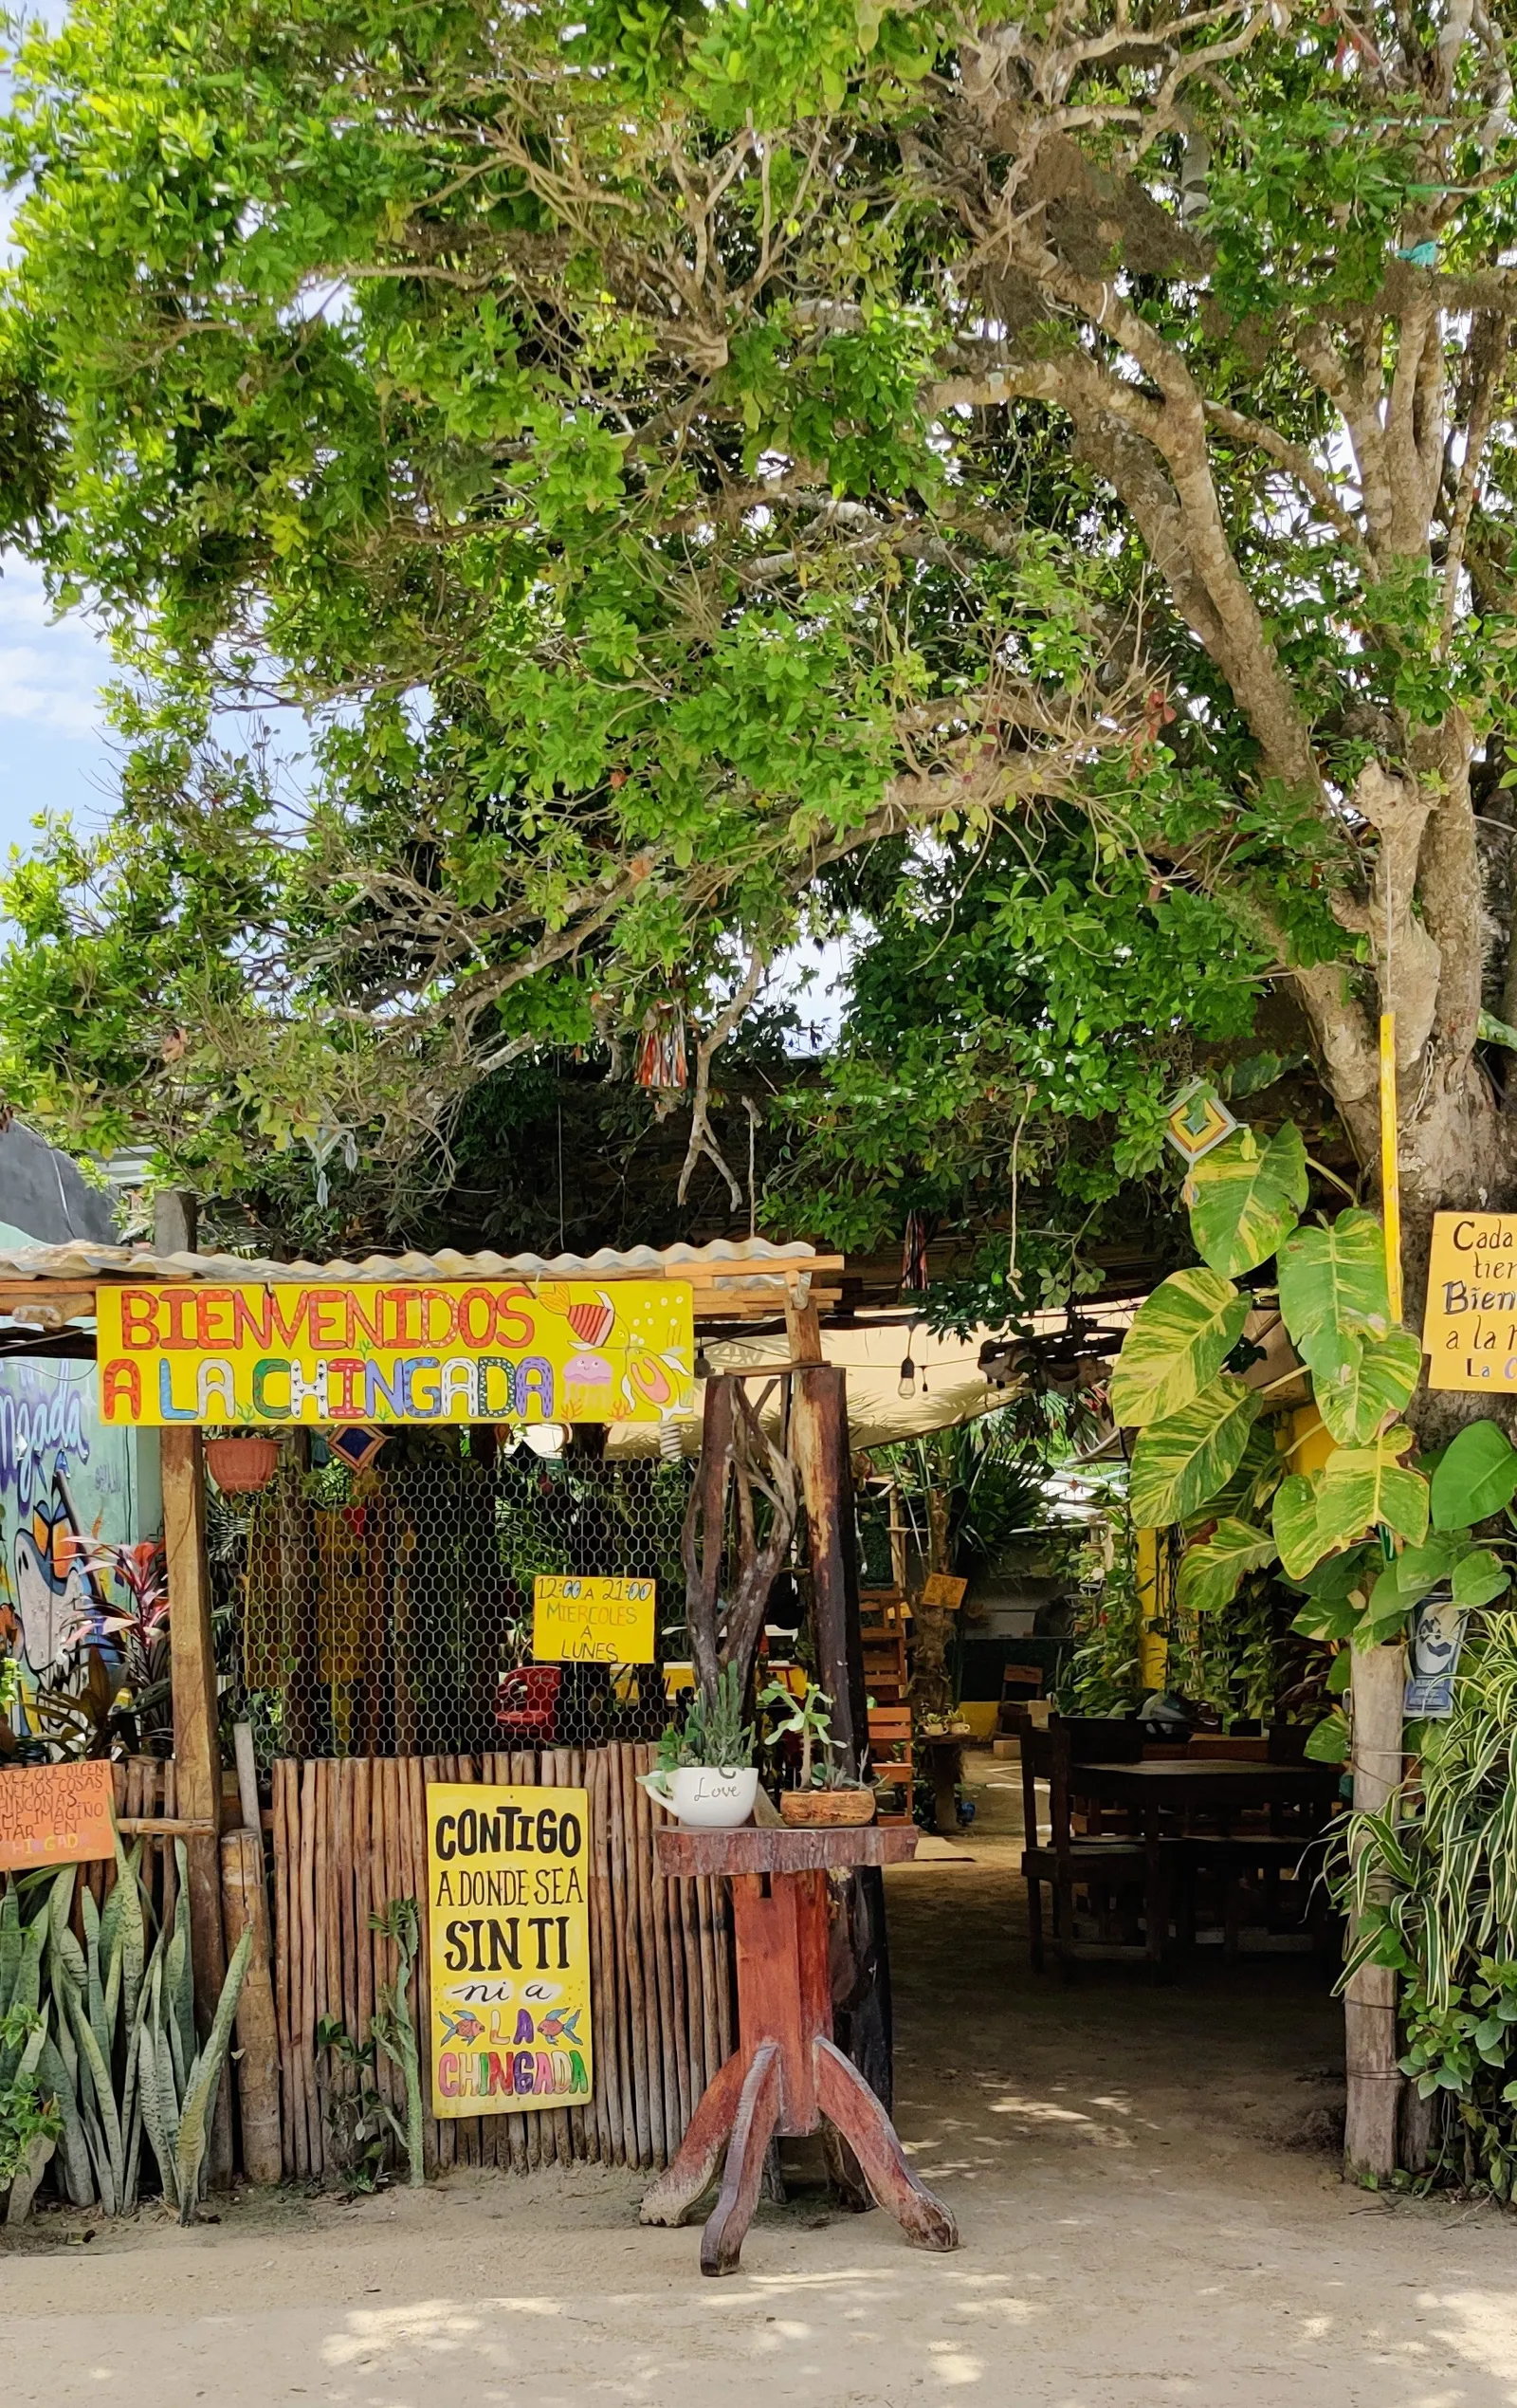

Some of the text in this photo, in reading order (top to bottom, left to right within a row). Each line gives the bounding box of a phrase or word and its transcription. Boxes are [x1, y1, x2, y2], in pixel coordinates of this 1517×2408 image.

[1453, 1219, 1513, 1251] Cada
[121, 1287, 535, 1351] BIENVENIDOS
[1446, 1331, 1460, 1350] a
[1473, 1315, 1497, 1350] la
[1467, 1358, 1490, 1377] La
[103, 1359, 141, 1420] A
[159, 1357, 236, 1420] LA
[252, 1356, 554, 1420] CHINGADA
[538, 1578, 653, 1602] 12:00 A 21:00
[547, 1601, 637, 1627] MIERCOLES
[580, 1625, 593, 1641] A
[561, 1639, 619, 1664] LUNES
[34, 1766, 61, 1781] QUE
[59, 1775, 102, 1792] COSAS
[693, 1777, 740, 1801] Love
[53, 1820, 77, 1835] EN
[436, 1806, 581, 1861] CONTIGO
[435, 1866, 584, 1906] A DONDE SEA
[444, 1916, 570, 1972] SIN TI
[451, 1981, 552, 2002] ni a
[489, 2009, 534, 2045] LA
[438, 2050, 589, 2097] CHINGADA
